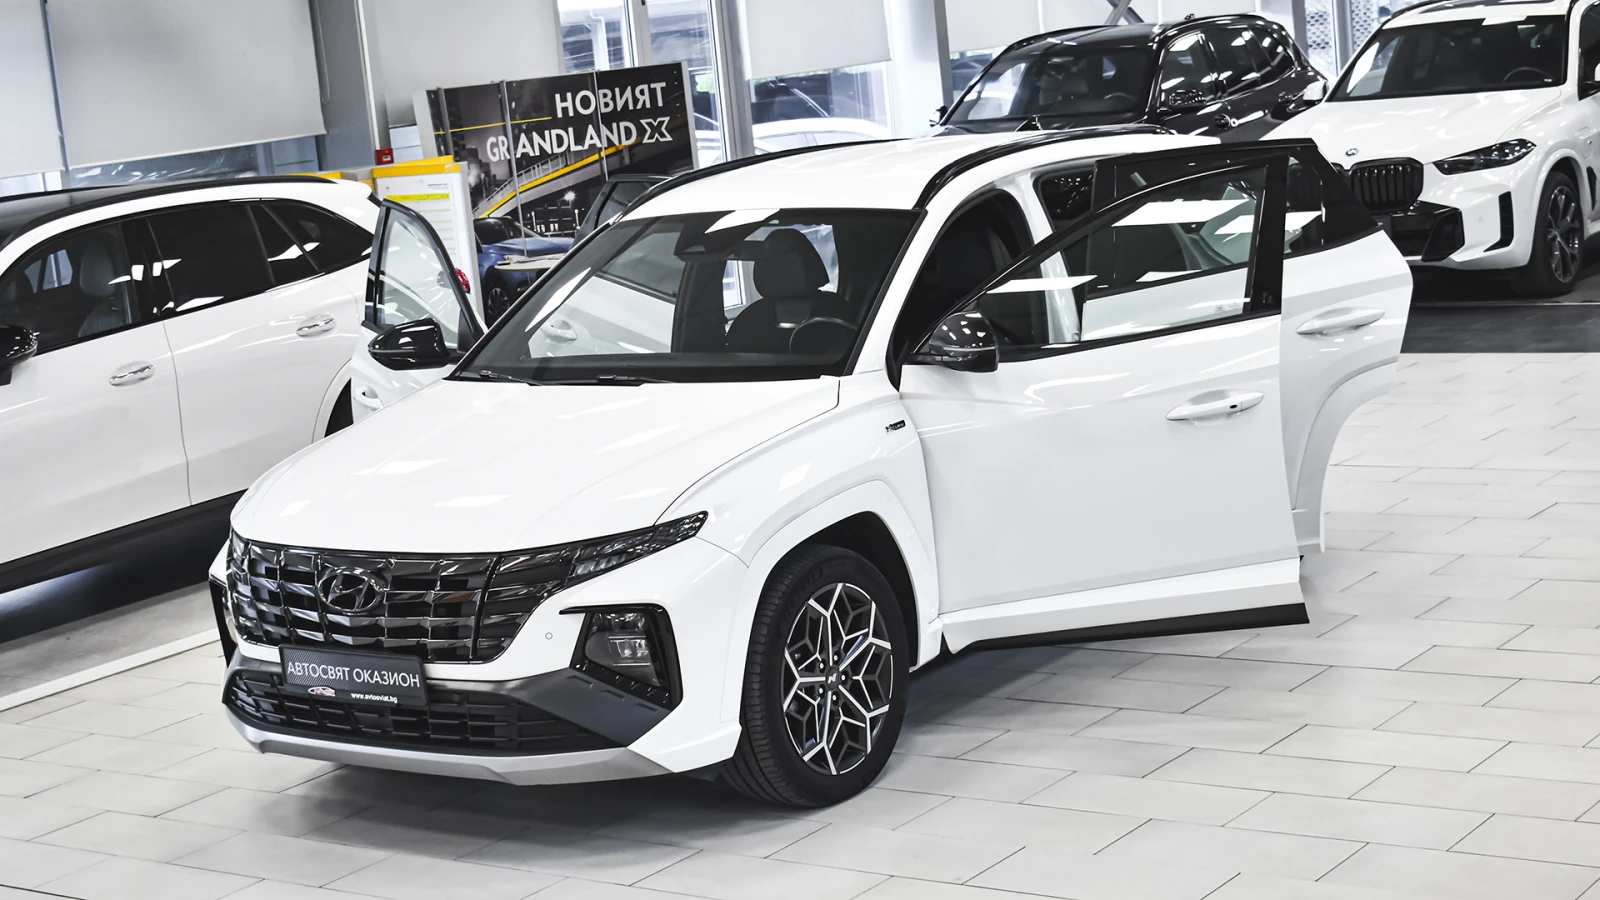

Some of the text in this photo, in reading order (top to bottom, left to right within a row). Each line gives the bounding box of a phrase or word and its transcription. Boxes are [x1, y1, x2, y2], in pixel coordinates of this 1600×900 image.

[555, 82, 666, 118] НОВИЯТ
[486, 121, 638, 162] GRANDLAND
[287, 661, 421, 688] АВТОСВЯТ ОКАЗИОН
